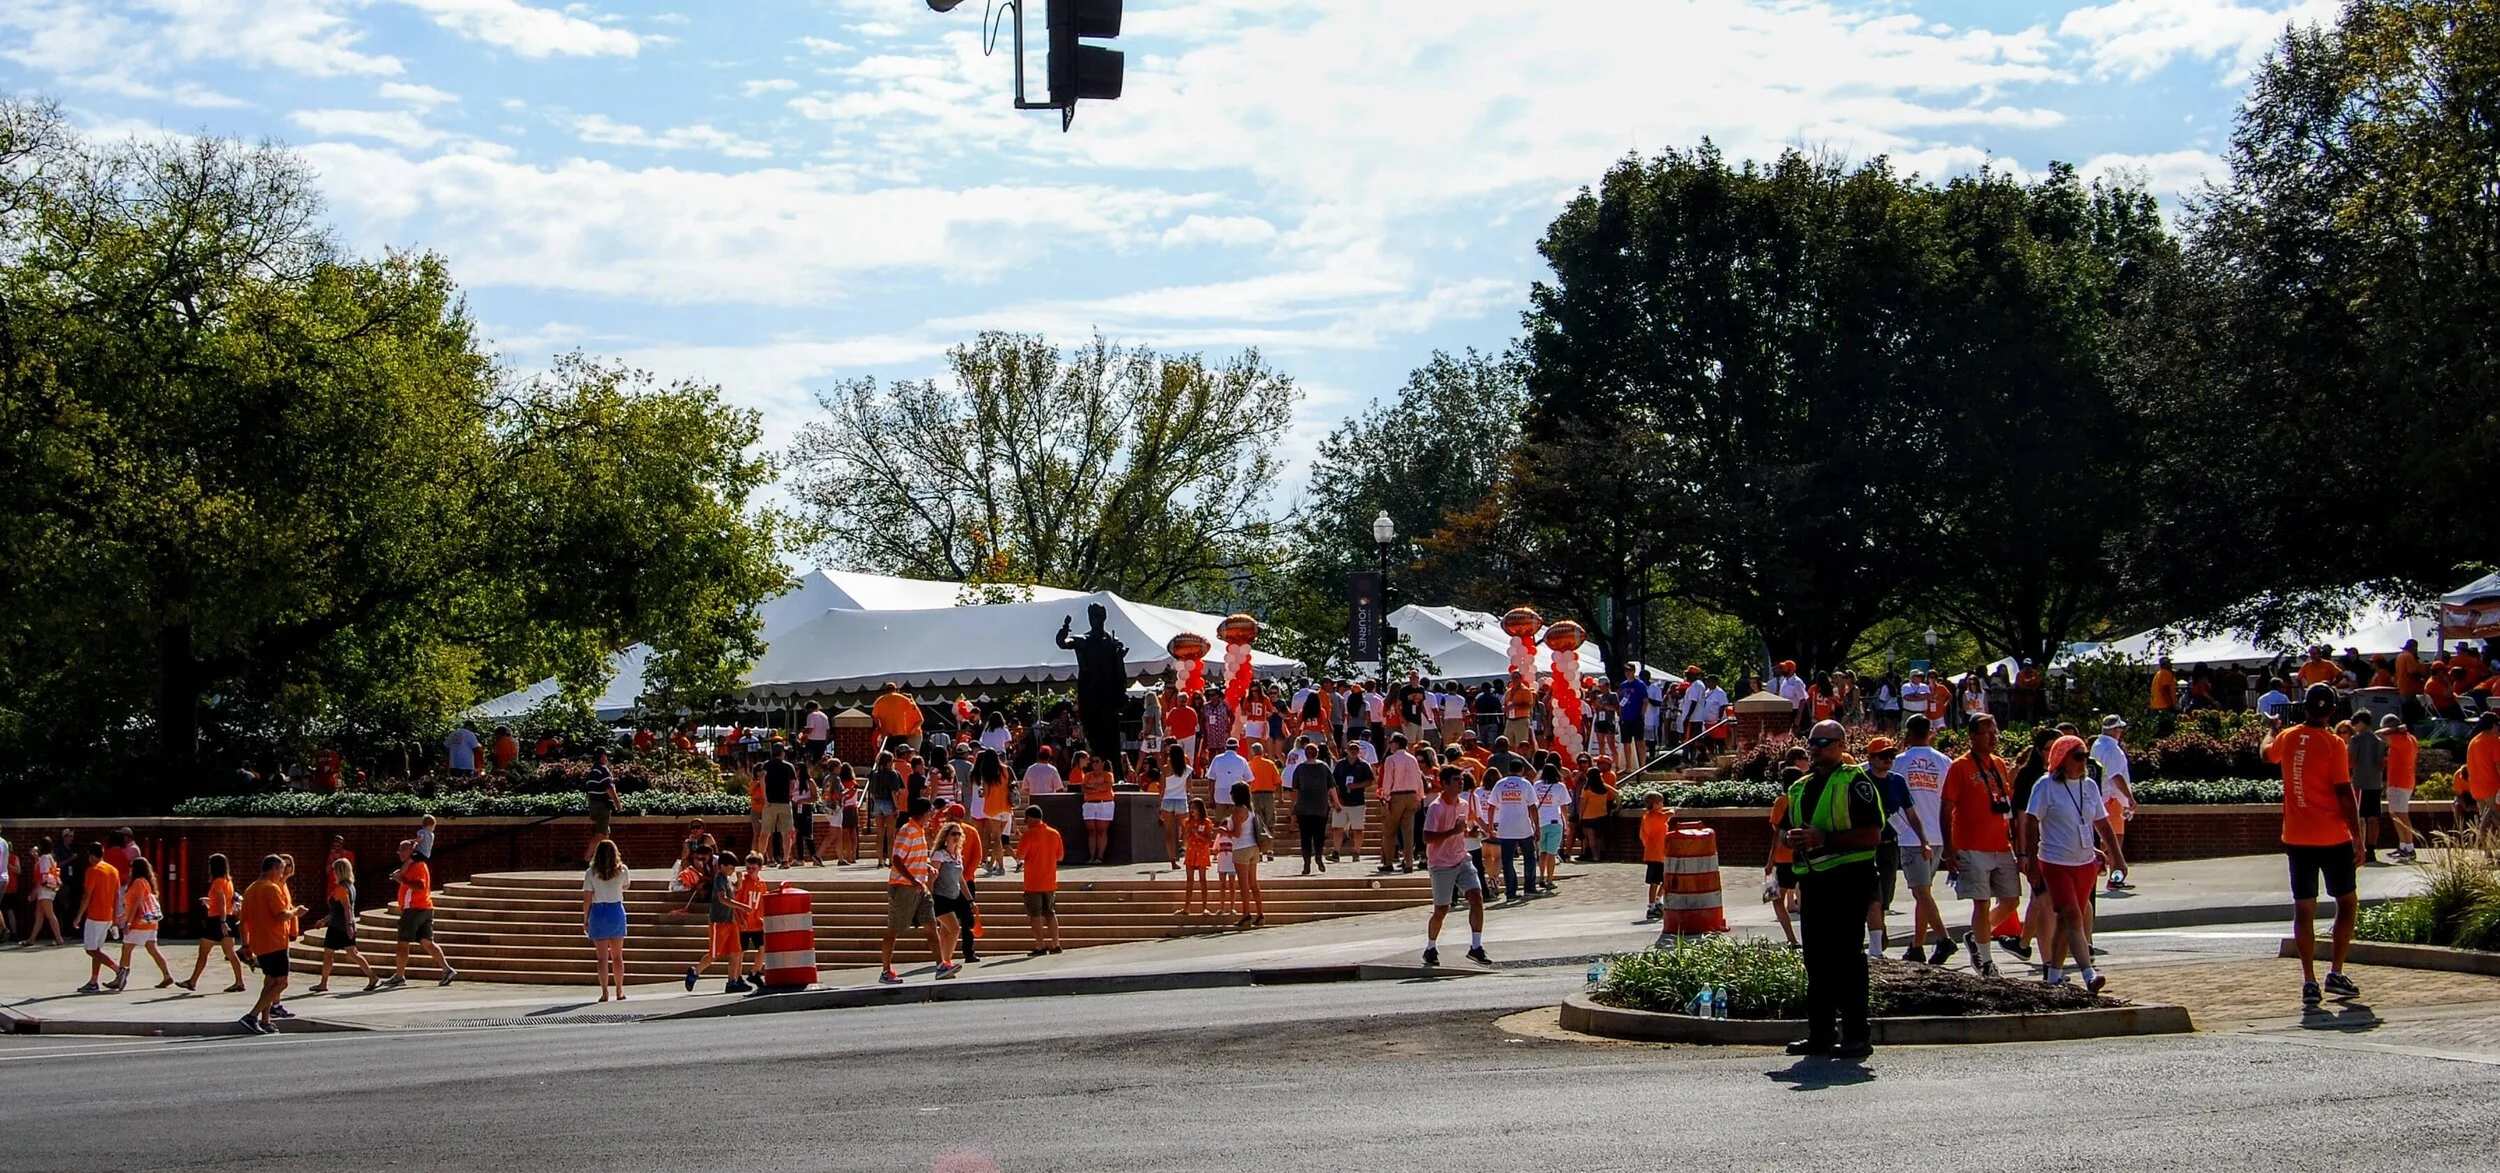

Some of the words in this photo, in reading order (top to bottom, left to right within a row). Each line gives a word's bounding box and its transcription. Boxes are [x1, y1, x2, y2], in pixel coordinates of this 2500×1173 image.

[1358, 607, 1367, 654] JOURNEY
[1251, 702, 1263, 716] 16
[2300, 735, 2310, 745] T
[1908, 773, 1938, 782] FAMILY
[748, 890, 761, 910] 14
